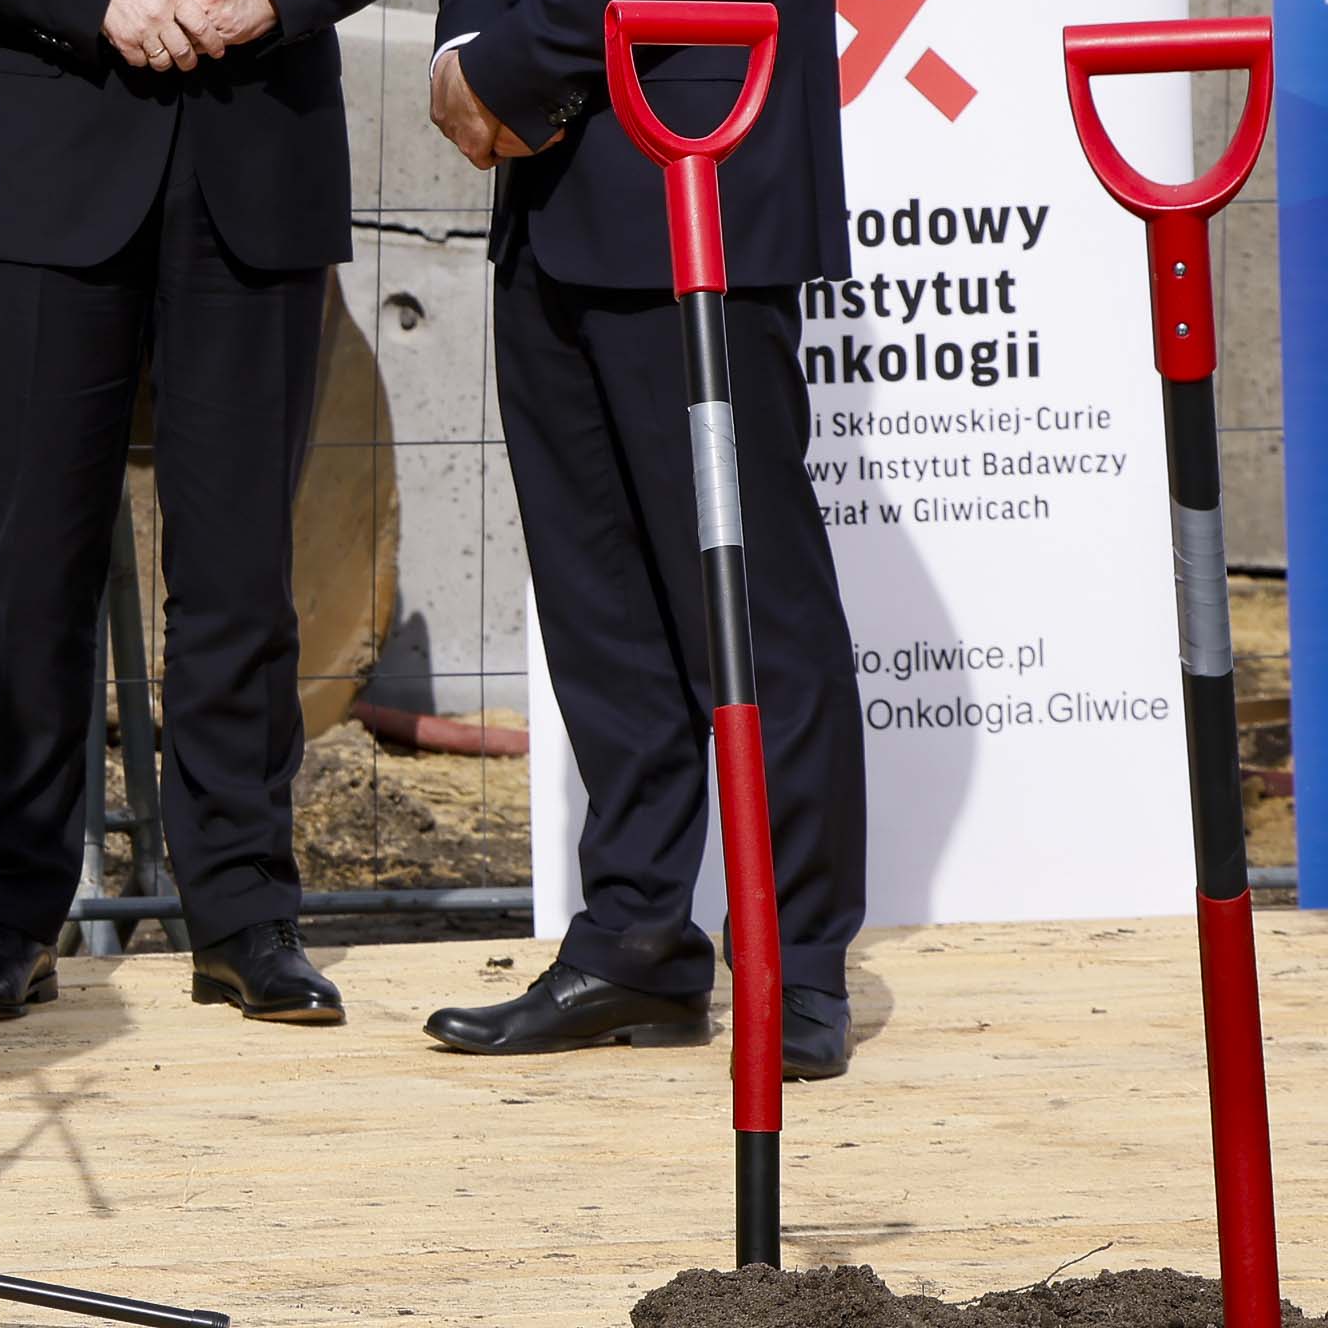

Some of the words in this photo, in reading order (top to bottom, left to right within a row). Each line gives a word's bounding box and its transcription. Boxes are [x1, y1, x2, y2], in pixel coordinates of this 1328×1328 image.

[845, 198, 1050, 251] odowy
[804, 268, 1016, 324] nstytut
[804, 330, 1039, 389] nkologii
[832, 406, 1112, 436] Skłodowskiej-Curie
[858, 455, 973, 483] Instytut
[982, 450, 1130, 477] Badawczy
[820, 500, 869, 526] ział
[879, 504, 902, 523] w
[912, 494, 1050, 522] Gliwicach
[865, 690, 1170, 734] Onkologia.Gliwice
